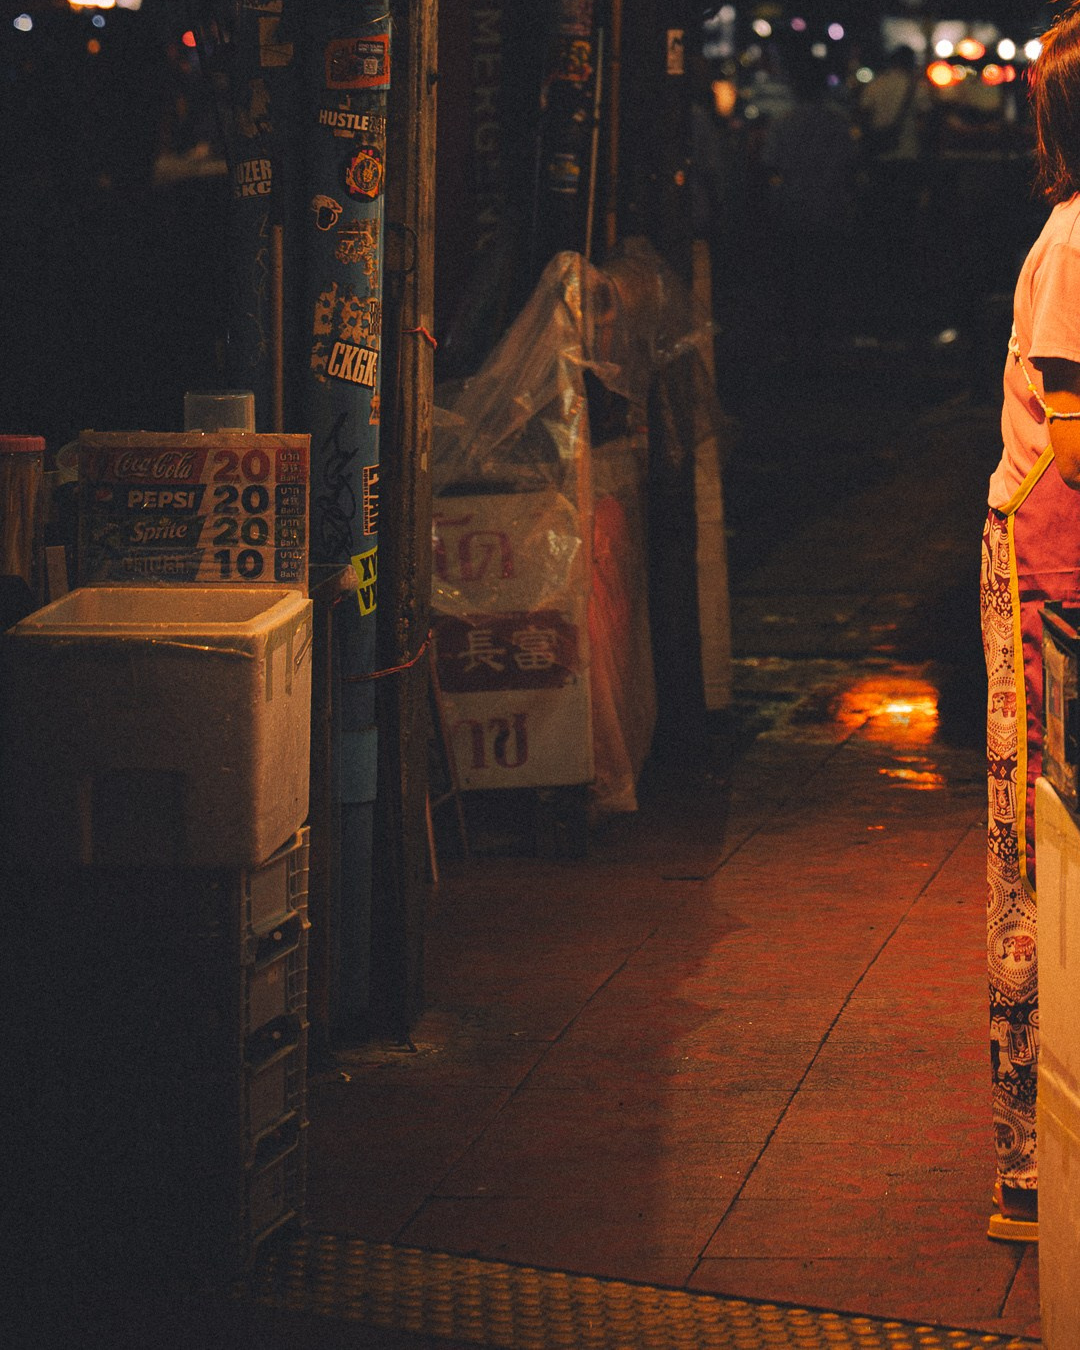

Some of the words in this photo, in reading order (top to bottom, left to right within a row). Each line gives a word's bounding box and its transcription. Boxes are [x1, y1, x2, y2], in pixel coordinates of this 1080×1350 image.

[319, 110, 369, 131] HUSTLE
[213, 449, 270, 483] 20
[128, 489, 196, 510] PEPSI
[213, 484, 270, 515] 20
[130, 517, 189, 544] Sprite
[212, 516, 269, 547] 20
[214, 549, 264, 579] 10
